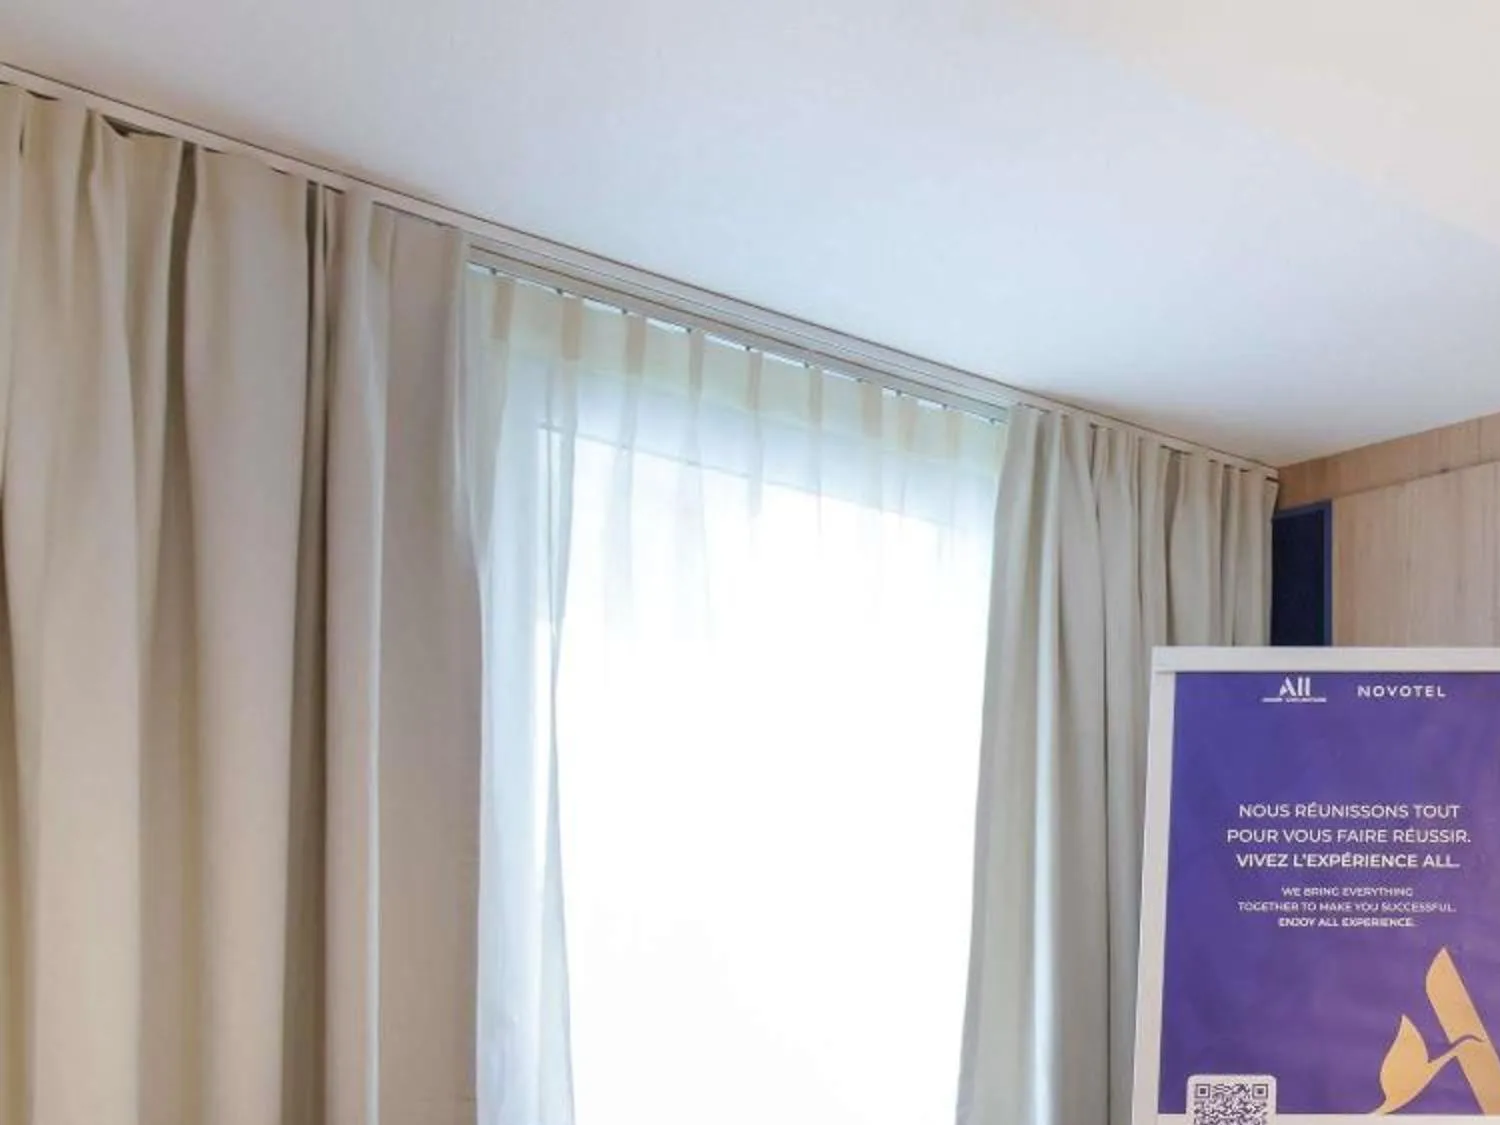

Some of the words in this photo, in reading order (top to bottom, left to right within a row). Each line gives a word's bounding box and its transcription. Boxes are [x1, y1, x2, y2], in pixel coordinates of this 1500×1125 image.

[1357, 685, 1446, 697] NOVOTEL
[1239, 804, 1291, 819] NOUS
[1295, 801, 1409, 819] RÉUNISSONS
[1413, 804, 1460, 819] TOUT
[1227, 829, 1279, 843] POUR
[1283, 829, 1333, 843] VOUS
[1337, 829, 1388, 843] FAIRE
[1392, 826, 1471, 843] RÉUSSIR.
[1236, 854, 1288, 868] VIVEZ
[1292, 851, 1419, 868] L'EXPÉRIENCE
[1281, 887, 1301, 897] WE
[1303, 887, 1340, 897] BRING
[1342, 887, 1414, 897] EVERYTHING
[1237, 901, 1299, 912] TOGETHER
[1301, 901, 1316, 912] TO
[1319, 902, 1353, 912] MAKE
[1354, 902, 1379, 912] YOU
[1278, 916, 1316, 927] ENJOY
[1317, 916, 1340, 927] ALL
